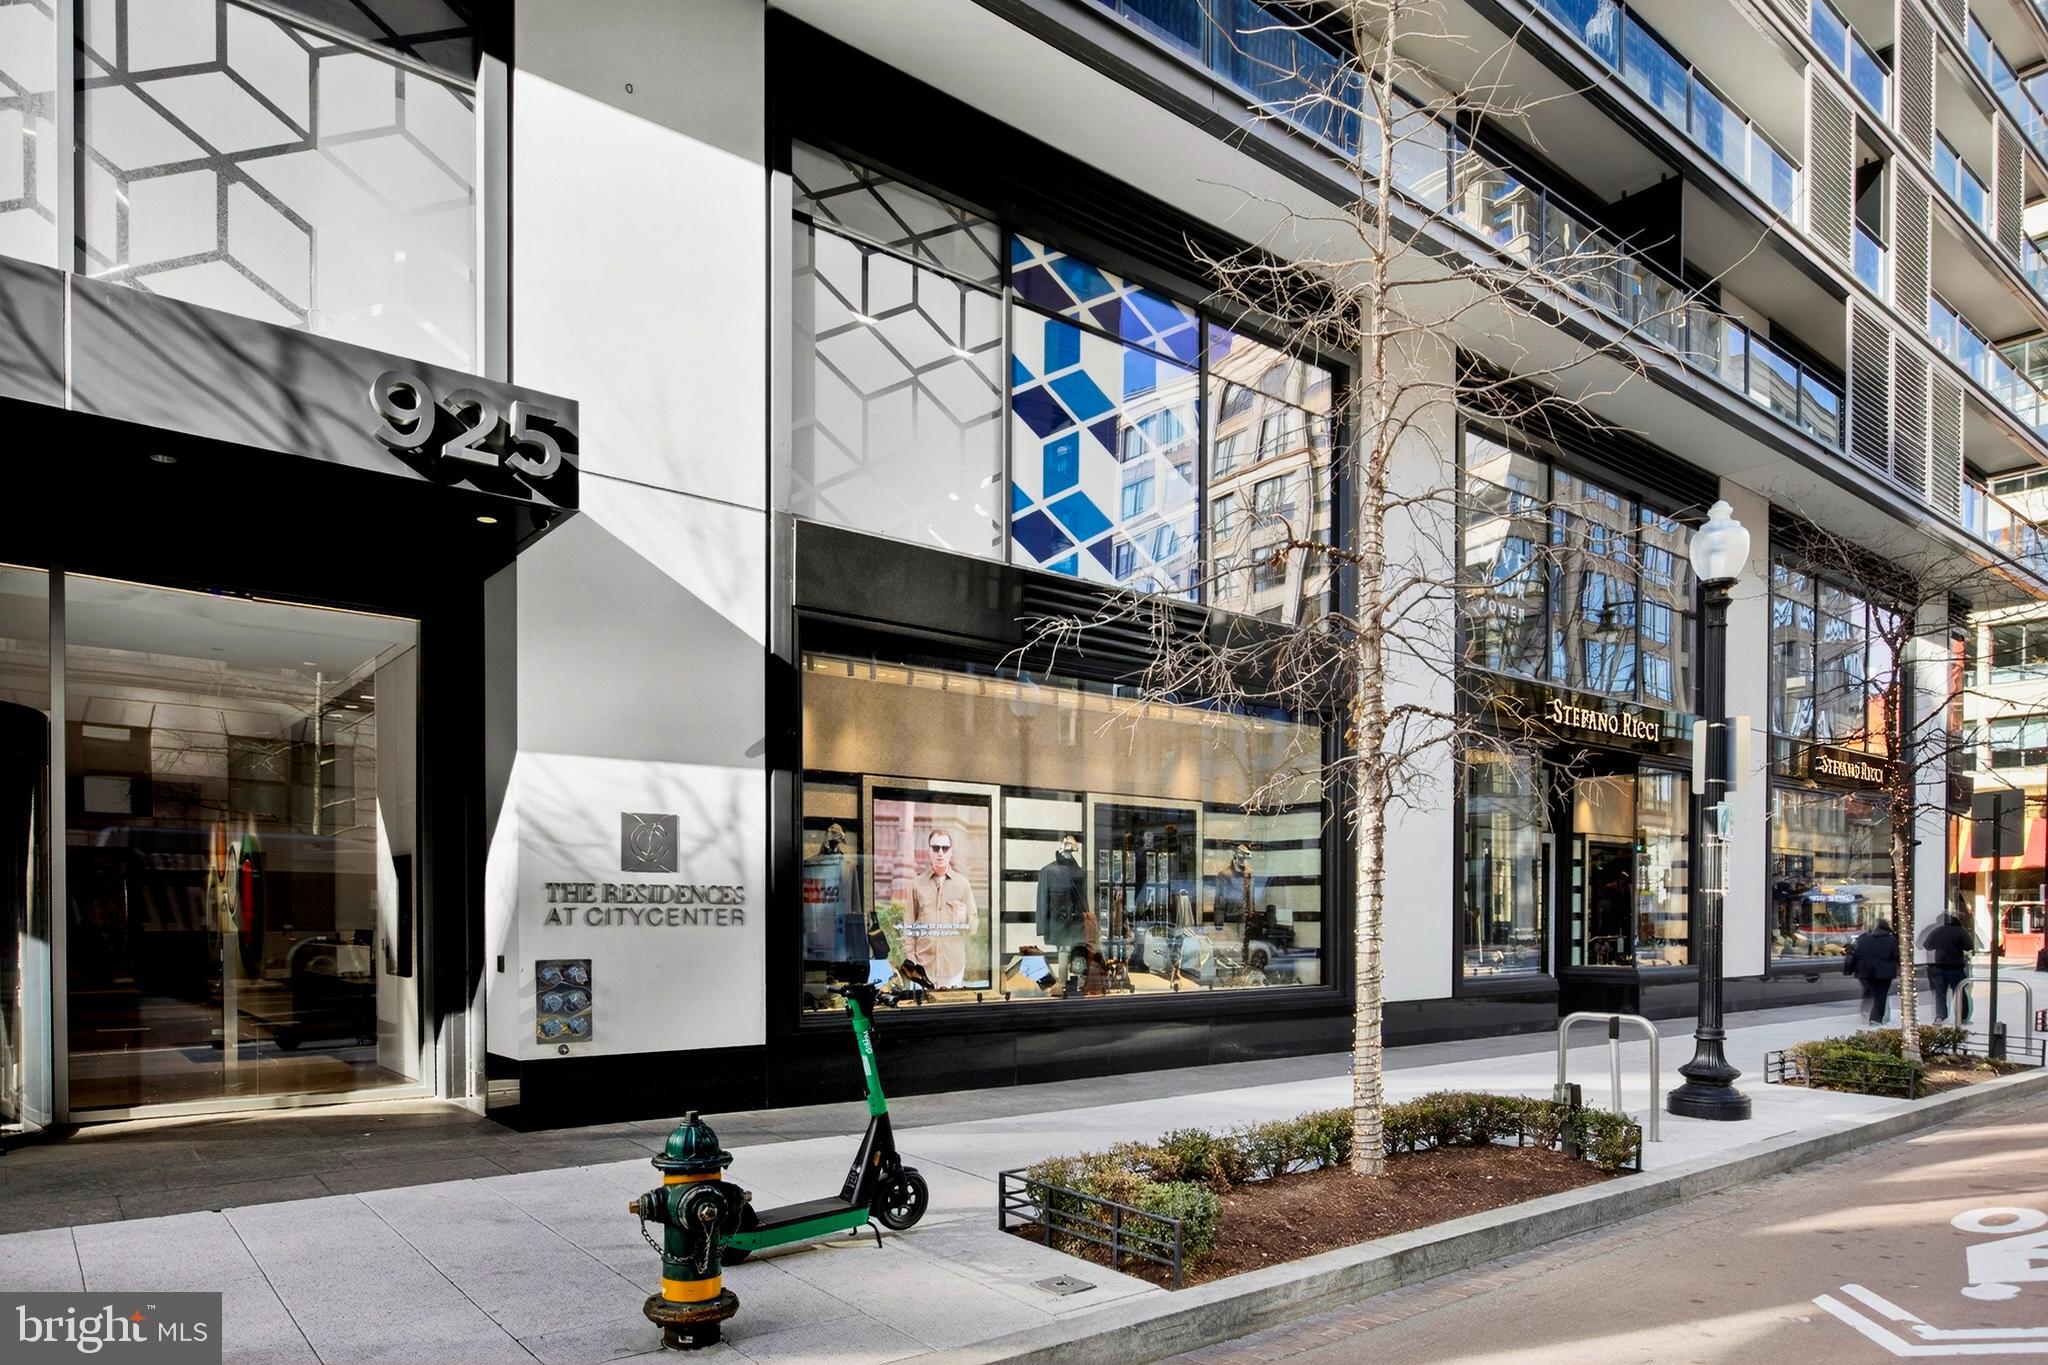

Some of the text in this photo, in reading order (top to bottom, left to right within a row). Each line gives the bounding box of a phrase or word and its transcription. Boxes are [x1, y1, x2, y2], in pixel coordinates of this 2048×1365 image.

[369, 370, 561, 477] 925
[1551, 698, 1660, 742] STEFANO RICCI
[545, 883, 745, 905] THE RESIDENCES
[545, 907, 744, 927] AT CITYCENTER
